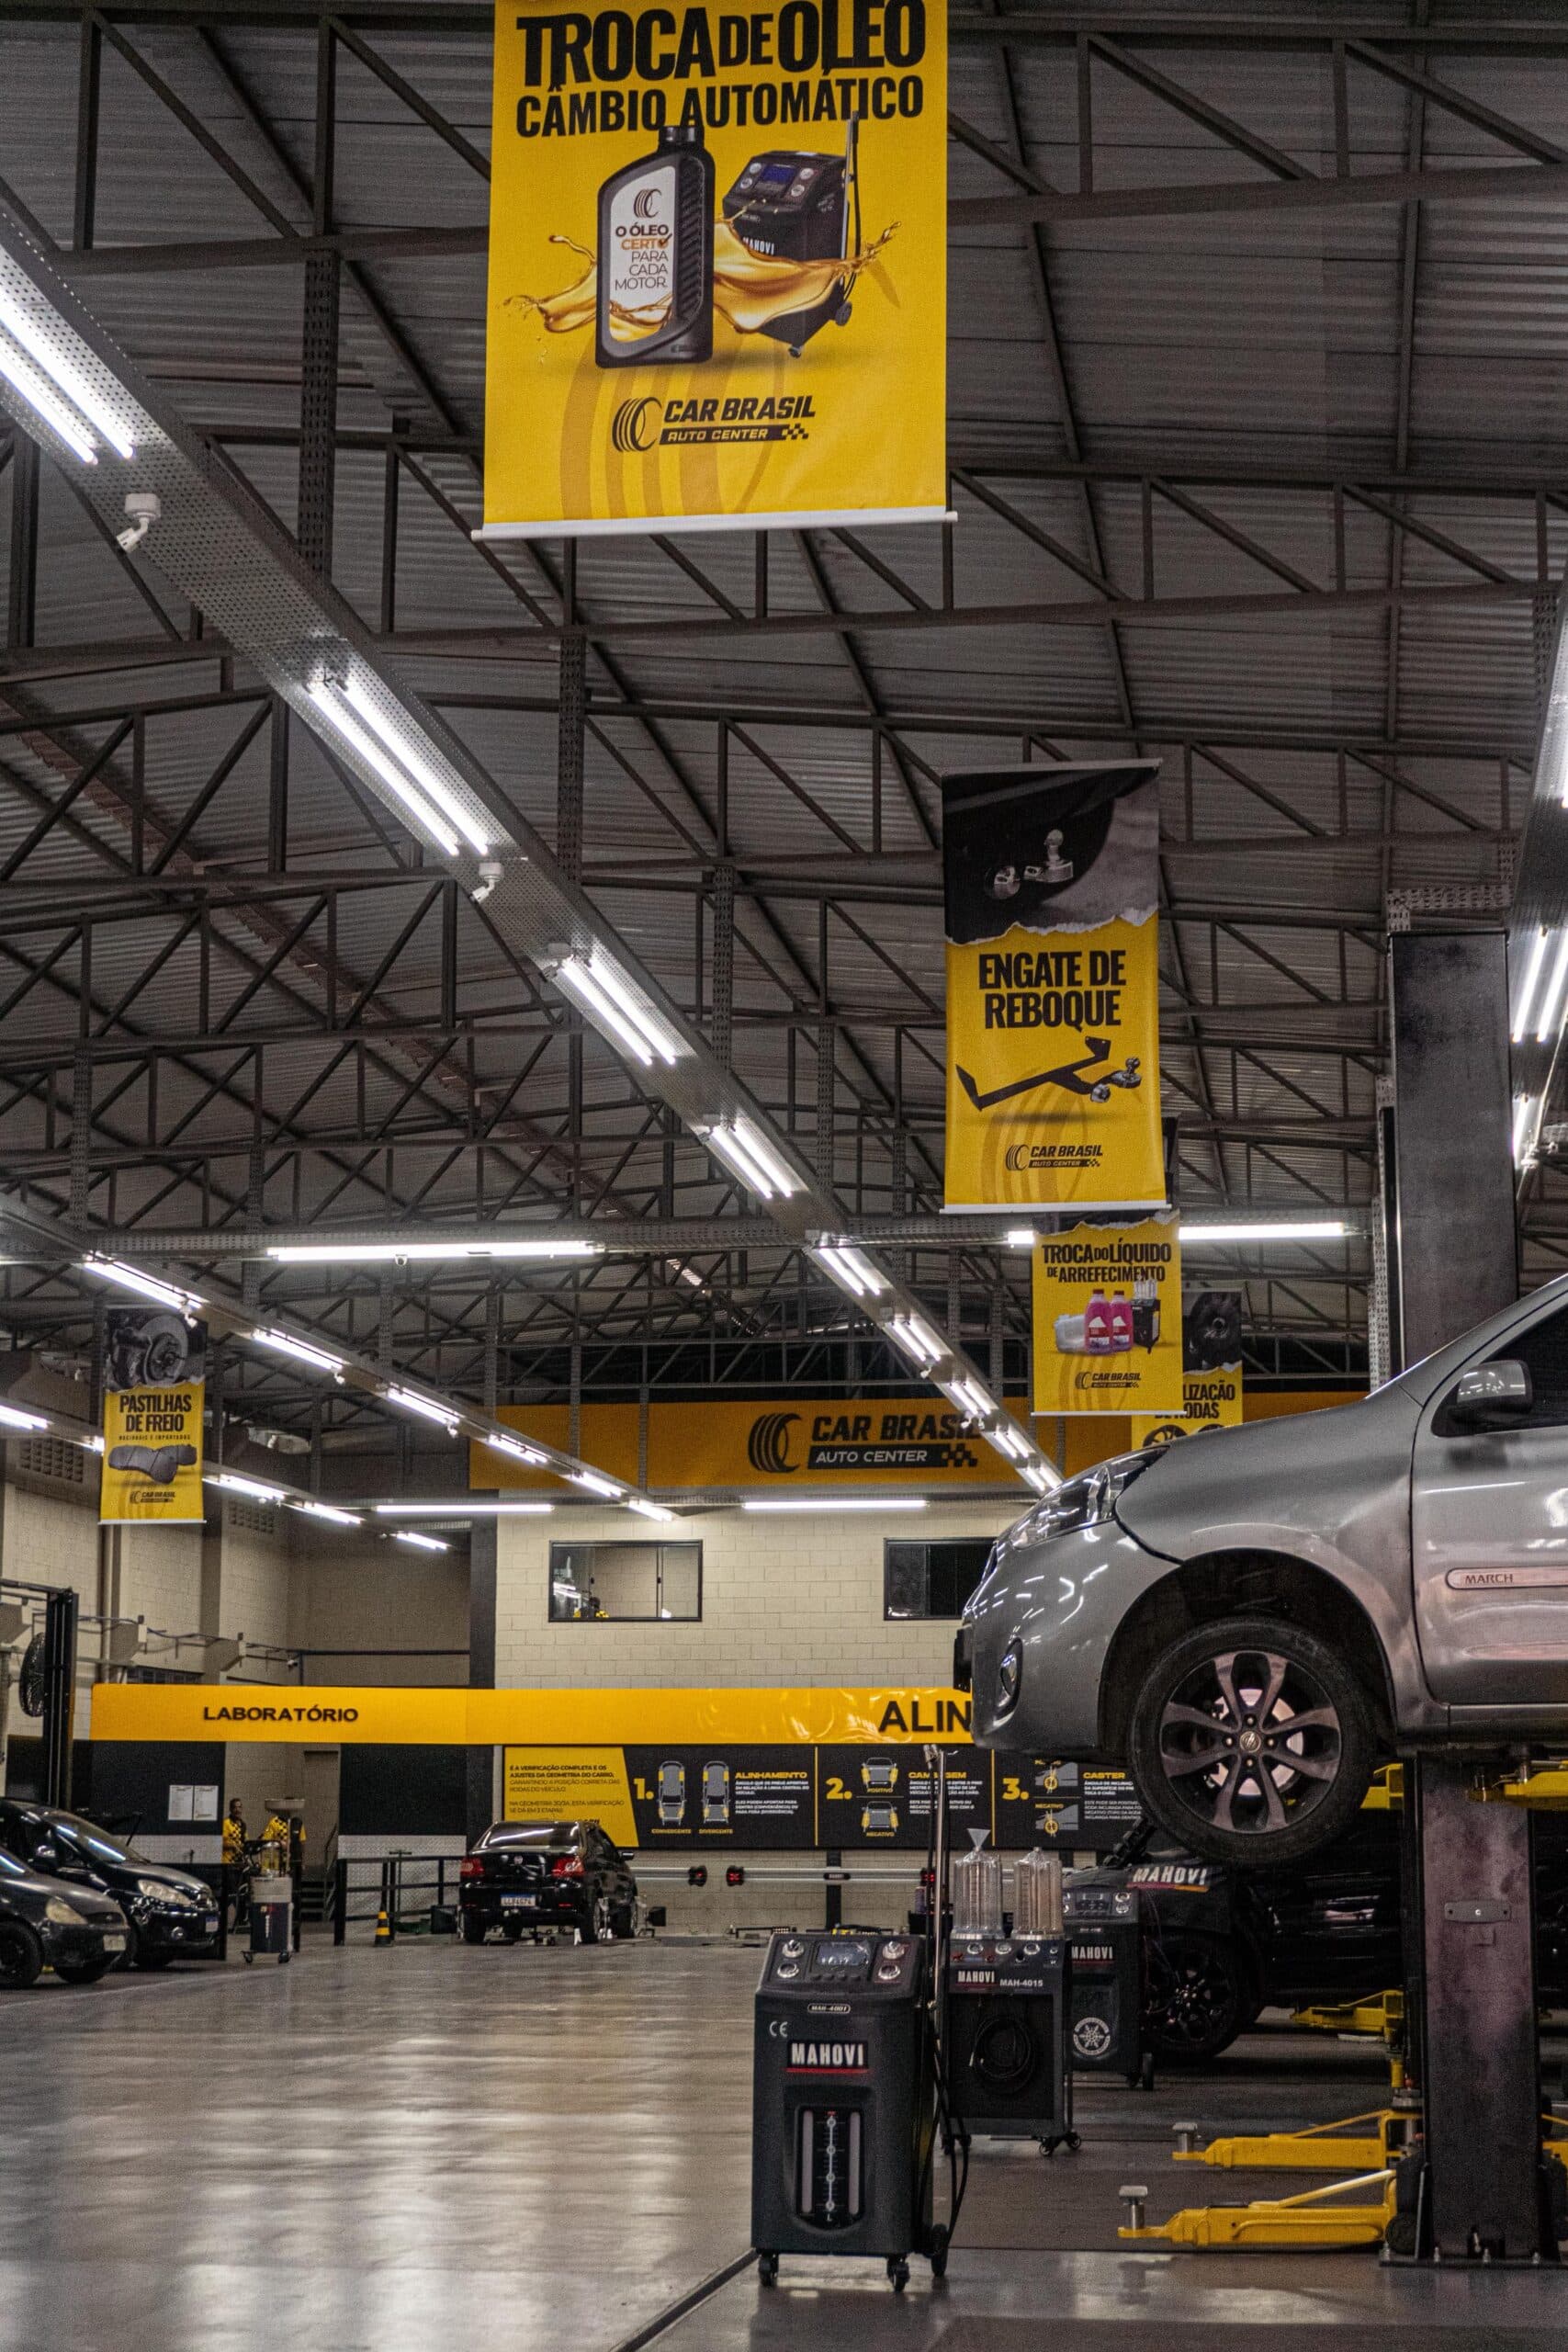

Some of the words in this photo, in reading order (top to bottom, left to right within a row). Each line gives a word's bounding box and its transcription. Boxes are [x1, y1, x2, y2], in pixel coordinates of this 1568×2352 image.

[516, 7, 716, 87] TROCA
[718, 14, 773, 68] DE
[516, 85, 666, 138] CÂMBIO
[680, 69, 923, 130] AUTOMÁTICO
[615, 226, 627, 237] O
[629, 222, 669, 237] ÓLEO
[621, 237, 669, 250] CERTO
[631, 250, 669, 263] PARA
[629, 263, 668, 277] CADA
[615, 277, 668, 291] MOTOR
[664, 399, 720, 423] CAR
[721, 395, 816, 421] BRASIL
[668, 431, 707, 442] AUTO
[711, 428, 768, 440] CENTER
[979, 951, 1080, 989] ENGATE
[1089, 950, 1126, 988] DE
[985, 989, 1122, 1033] REBOQUE
[1031, 1146, 1056, 1158] CAR
[1057, 1145, 1102, 1157] BRASIL
[1042, 1244, 1093, 1264] TROCA
[1094, 1248, 1109, 1261] DO
[1109, 1238, 1171, 1265] LÍQUIDO
[1047, 1267, 1058, 1277] DE
[1058, 1266, 1166, 1283] ARREFECIMENTO
[120, 1395, 192, 1413] PASTILHAS
[126, 1414, 144, 1431] DE
[145, 1413, 184, 1431] FREIO
[811, 1415, 872, 1442] CAR
[816, 1452, 858, 1463] AUTO
[863, 1450, 928, 1463] CENTER
[1465, 1574, 1513, 1584] MARCH
[203, 1704, 358, 1723] LABORATÓRIO
[878, 1700, 972, 1733] ALIN
[826, 1778, 852, 1800] 2.
[1002, 1778, 1029, 1800] 3.
[1133, 1865, 1207, 1885] MAHOVI
[1072, 1946, 1112, 1960] MAHOVI
[958, 1971, 995, 1983] MAHOVI
[999, 1979, 1043, 1987] MAH-4015
[791, 2042, 863, 2066] MAHOVI
